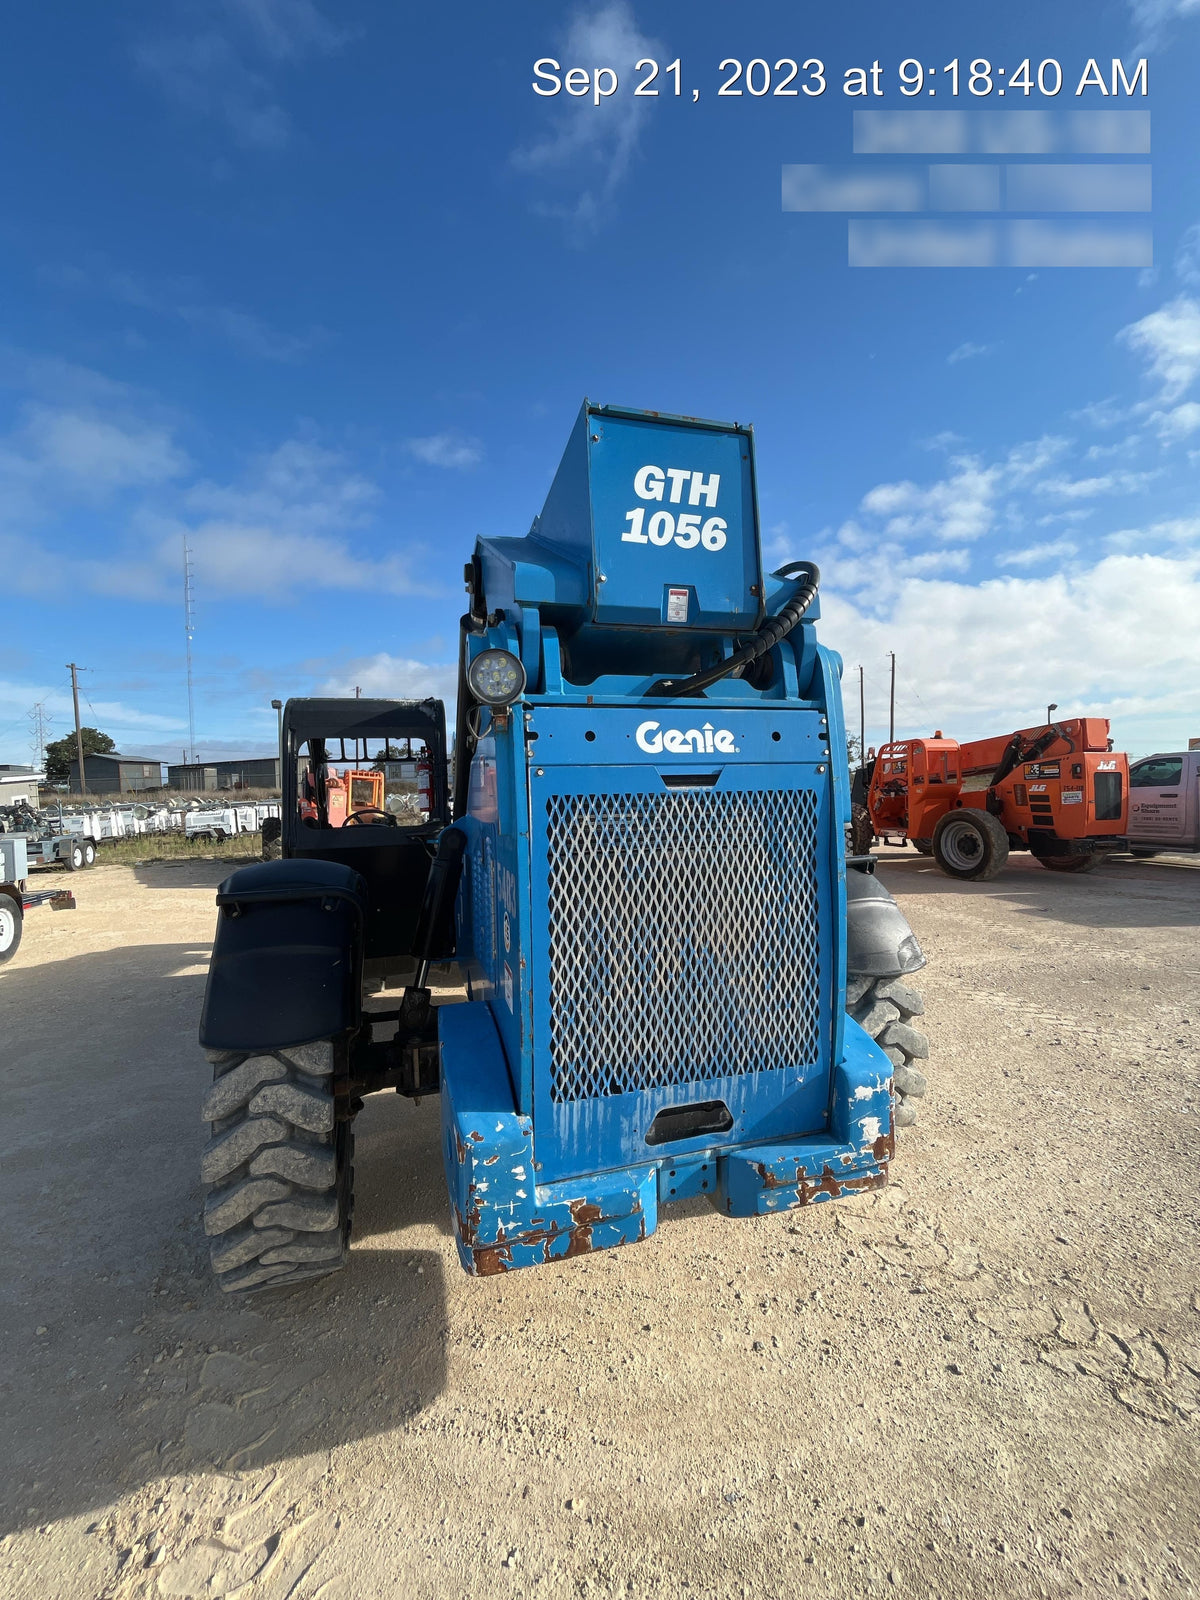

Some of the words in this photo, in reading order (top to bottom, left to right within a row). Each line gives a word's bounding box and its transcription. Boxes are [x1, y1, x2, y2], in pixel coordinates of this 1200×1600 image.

[635, 466, 720, 508] GTH
[621, 507, 728, 552] 1056
[635, 720, 736, 754] Genie
[1097, 760, 1117, 770] JLG
